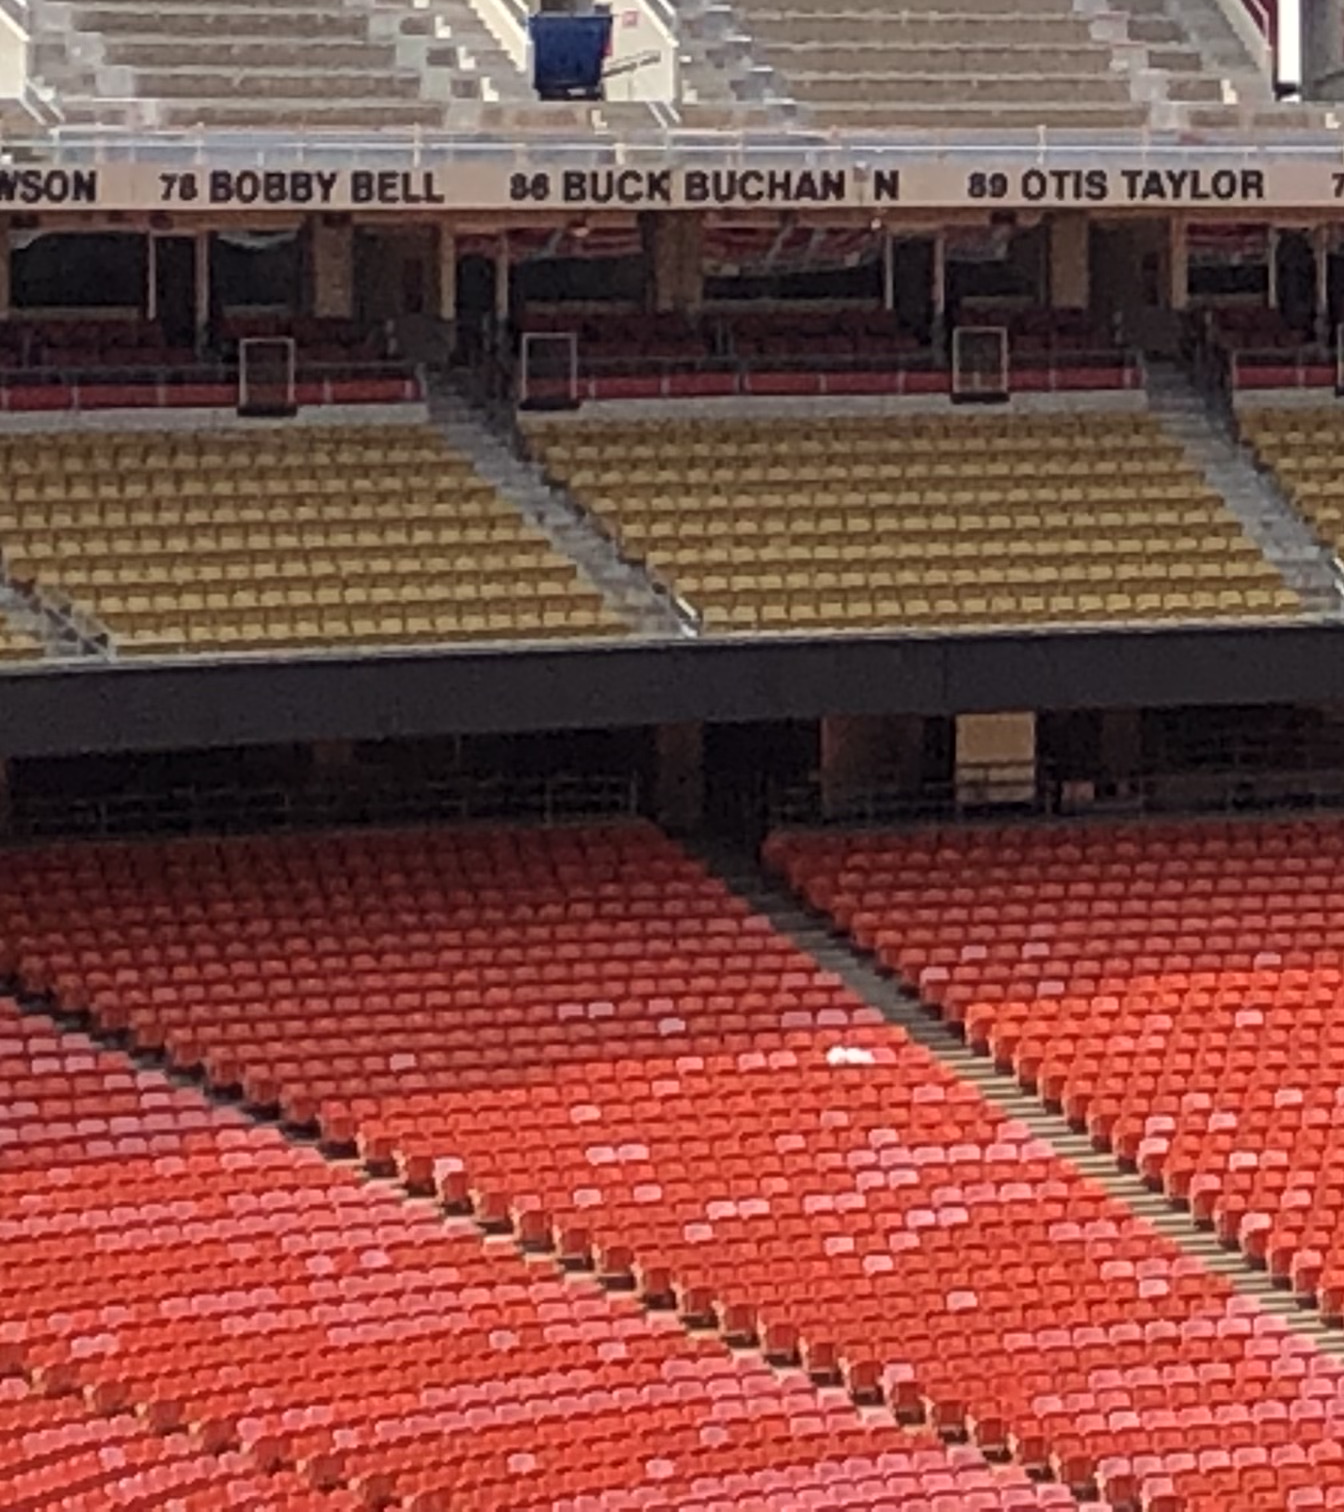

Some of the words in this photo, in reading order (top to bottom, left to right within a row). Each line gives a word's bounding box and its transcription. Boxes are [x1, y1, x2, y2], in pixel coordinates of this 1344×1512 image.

[159, 173, 199, 201] 78
[208, 170, 337, 204] BOBBY
[350, 170, 446, 203] BELL
[562, 170, 672, 203] BUCK
[1021, 169, 1108, 201] OTIS
[1121, 169, 1265, 200] TAYLOR
